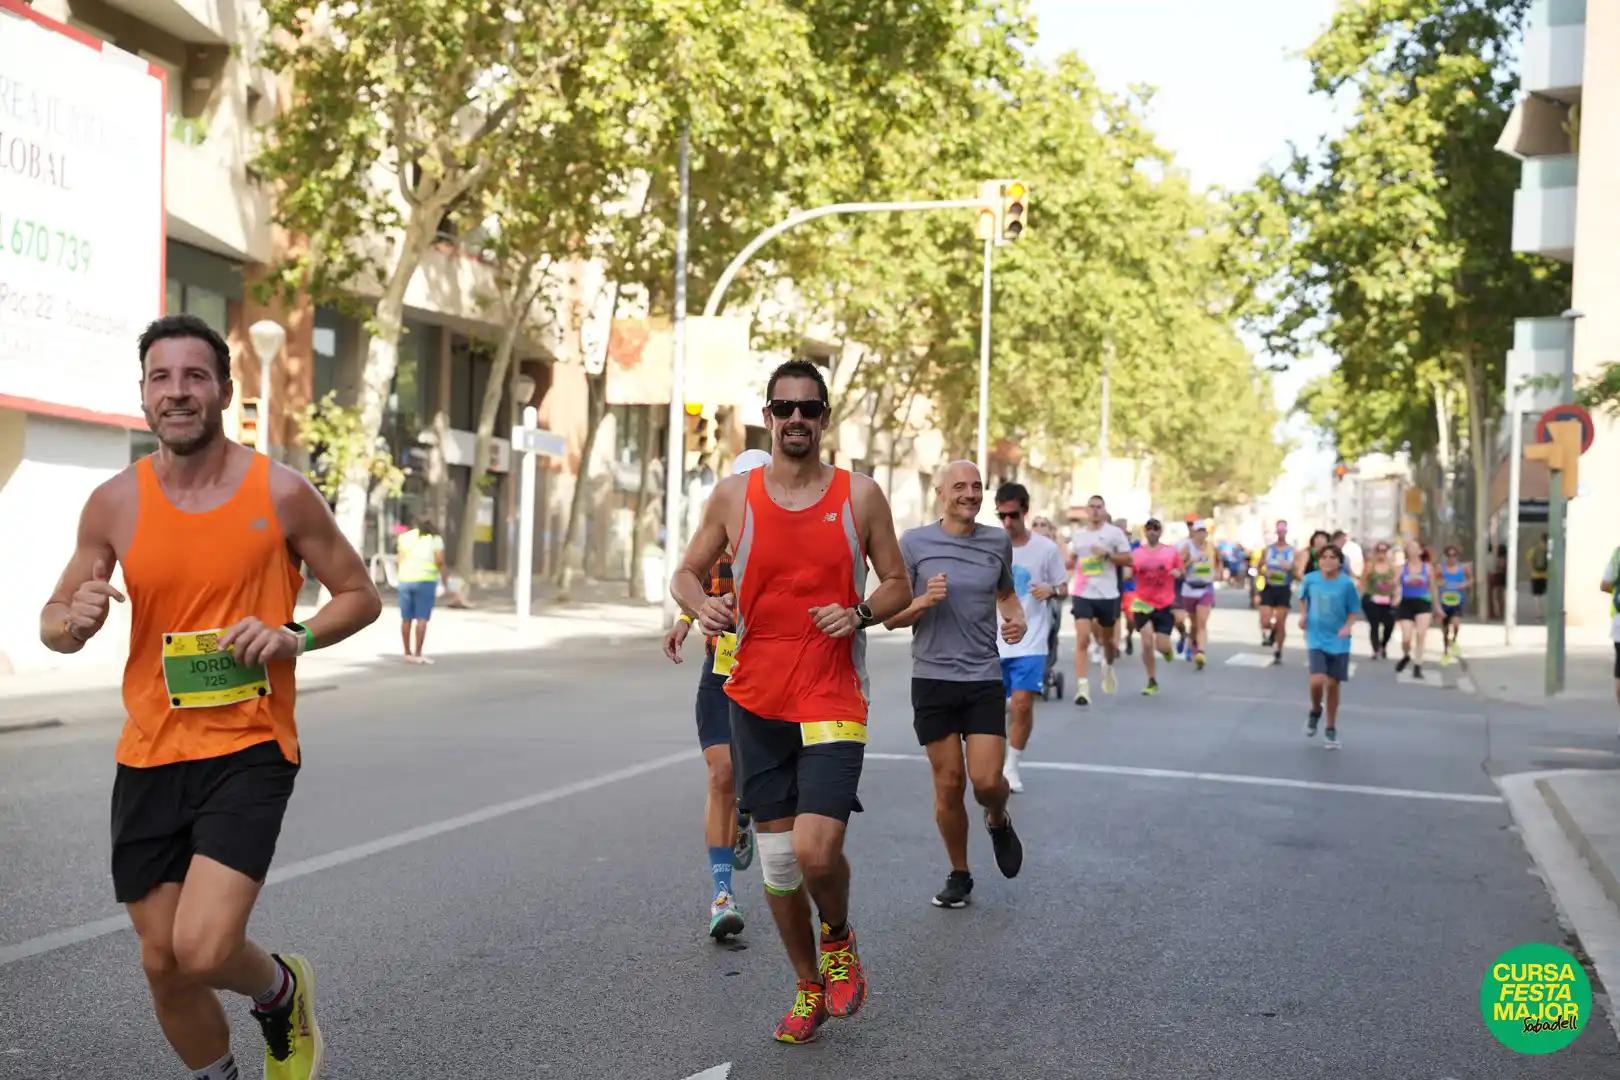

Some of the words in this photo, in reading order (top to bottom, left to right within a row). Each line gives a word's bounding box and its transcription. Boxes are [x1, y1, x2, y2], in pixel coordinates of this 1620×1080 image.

[11, 217, 49, 262] 670
[56, 230, 91, 275] 739
[203, 675, 228, 687] 725
